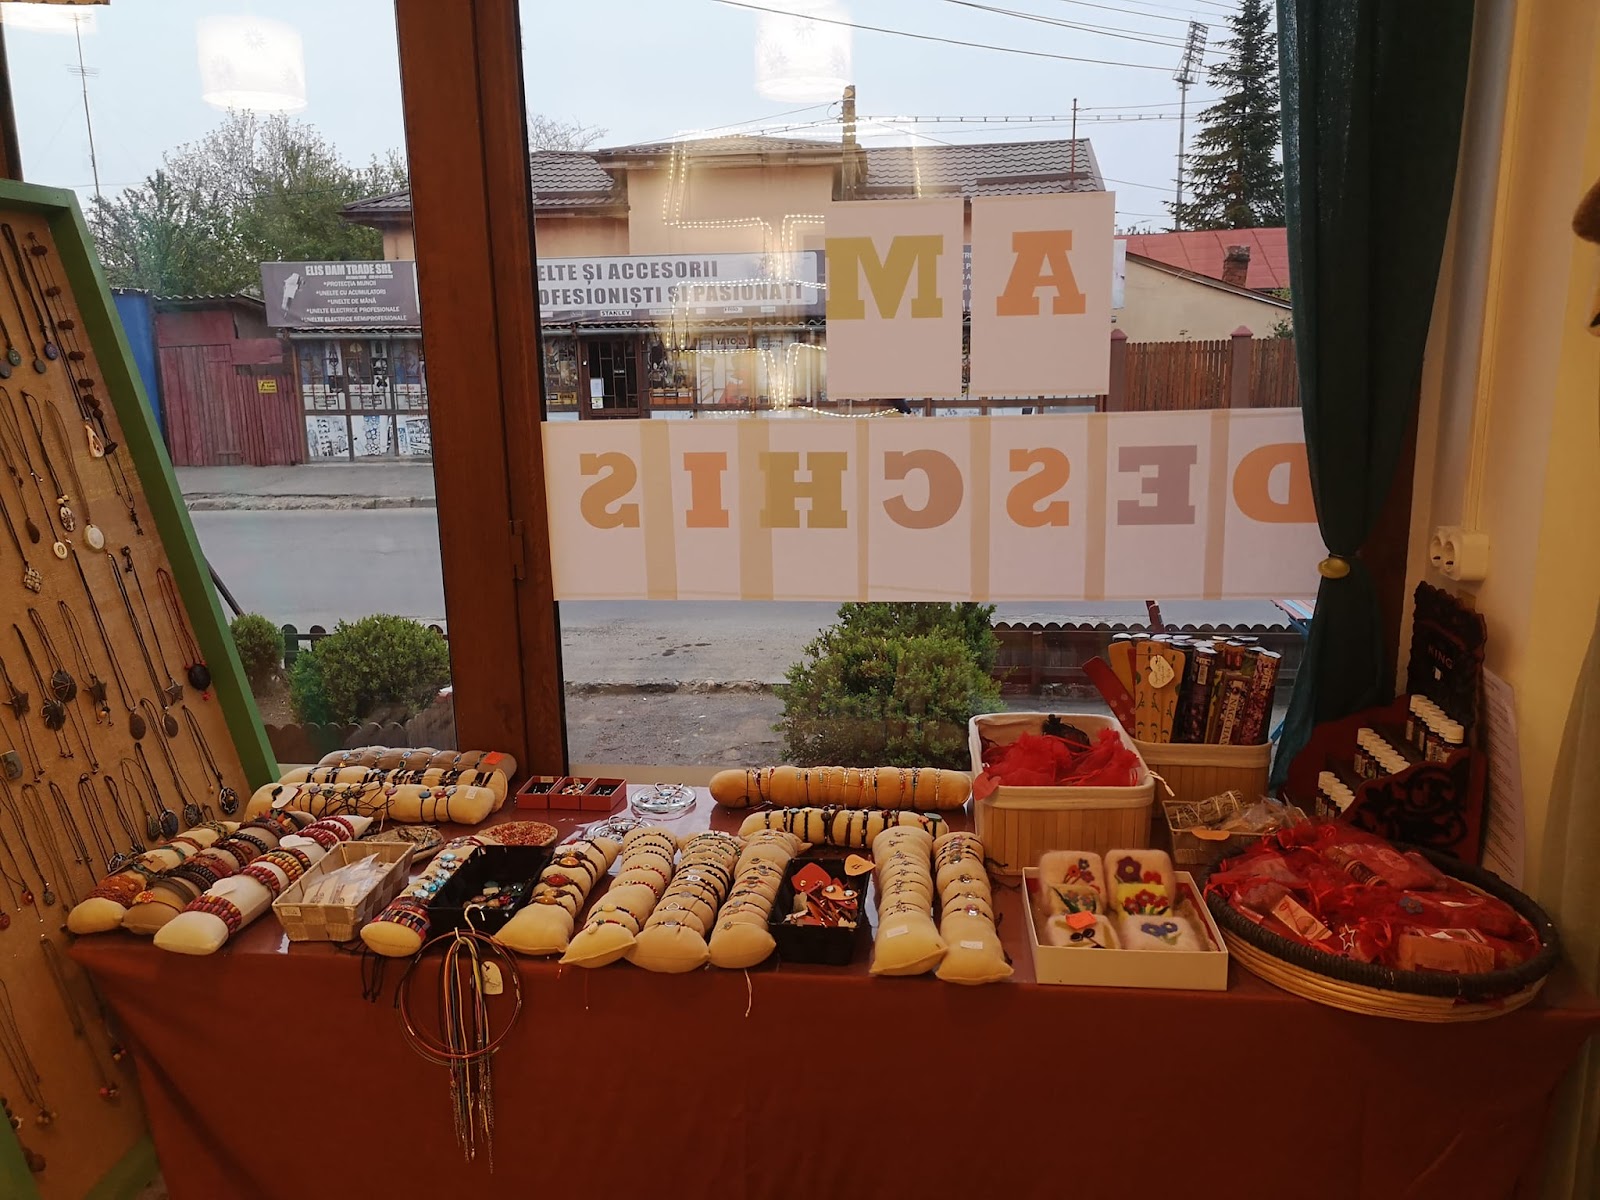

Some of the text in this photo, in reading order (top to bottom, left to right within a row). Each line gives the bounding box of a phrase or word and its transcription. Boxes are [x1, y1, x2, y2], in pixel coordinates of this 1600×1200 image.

[305, 263, 394, 276] ELIS DAM TRADE SRL
[537, 260, 718, 286] ELTE ȘI ACCESORII
[539, 286, 662, 308] OFESIONIȘTI
[716, 337, 738, 345] YATO
